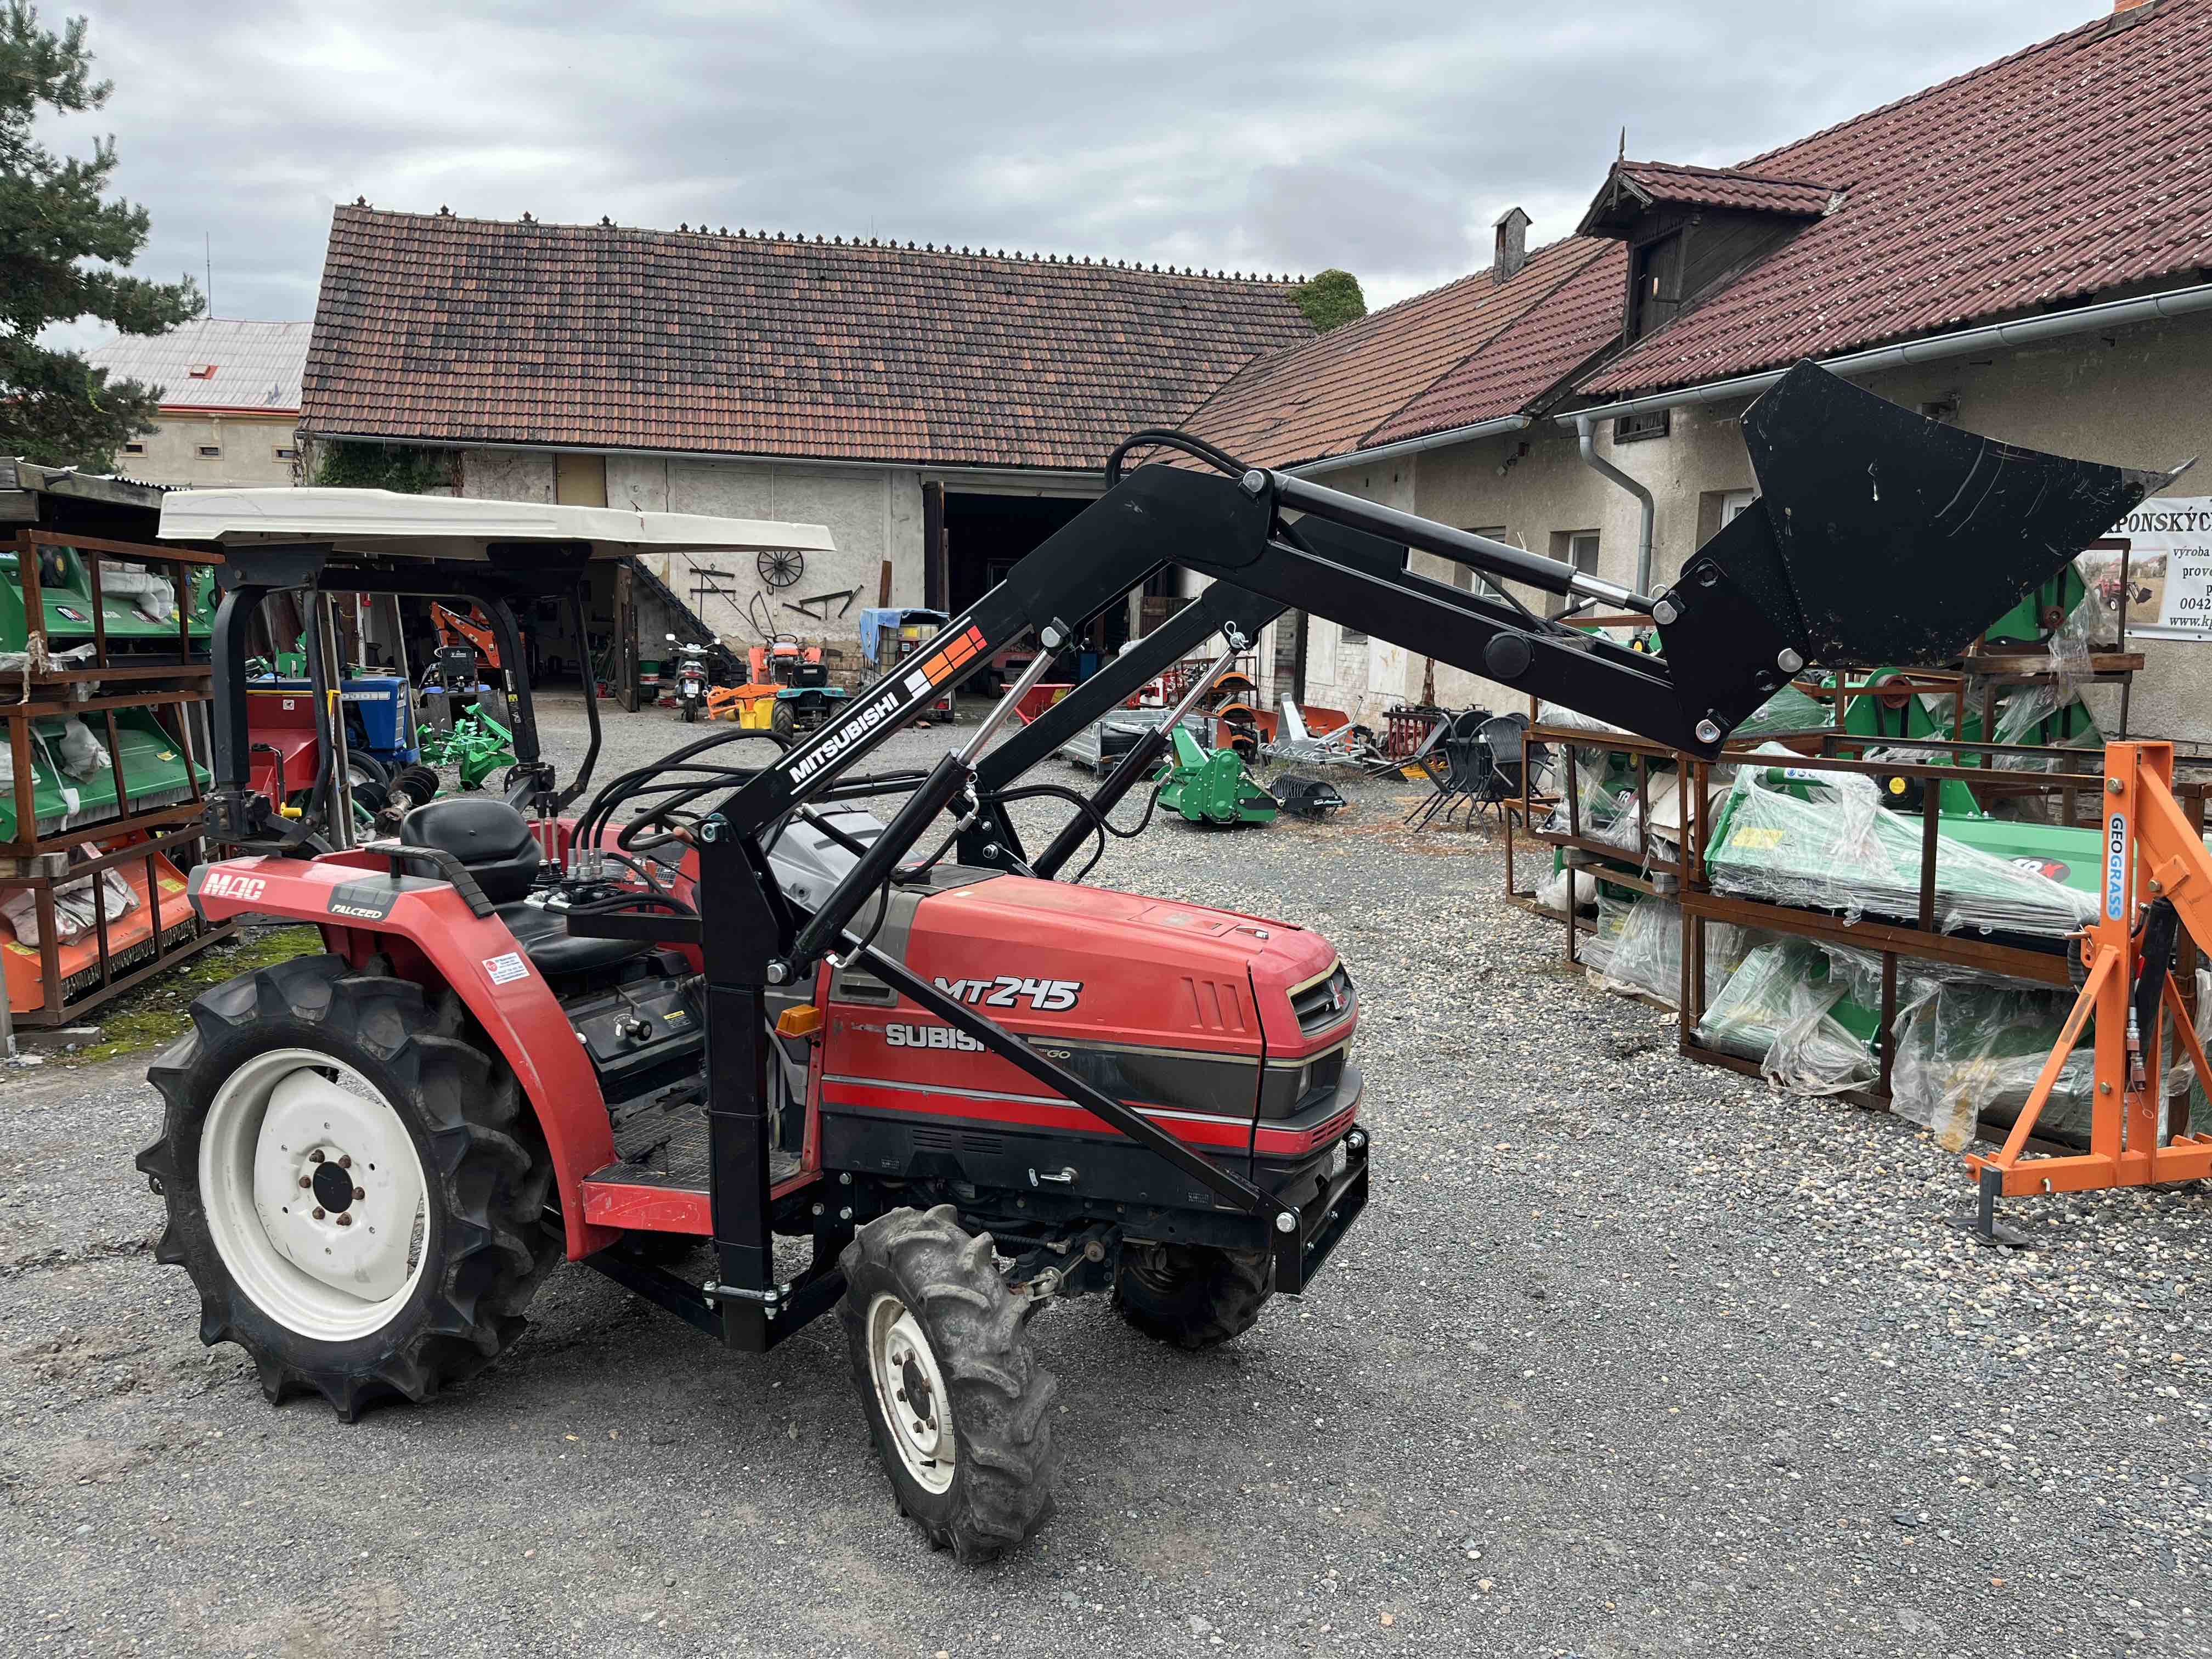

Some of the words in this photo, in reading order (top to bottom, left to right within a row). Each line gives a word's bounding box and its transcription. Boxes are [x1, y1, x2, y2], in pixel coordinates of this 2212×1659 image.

[2107, 506, 2212, 533] PONSKÝC
[2174, 545, 2210, 558] výroba
[2180, 598, 2211, 610] 0042
[789, 692, 899, 783] MITSUBISHI
[2108, 817, 2124, 917] GEOGRASS
[203, 873, 266, 900] MAC
[933, 976, 1083, 1011] MT245
[885, 1023, 986, 1052] SUBIS
[1047, 1049, 1071, 1059] GO
